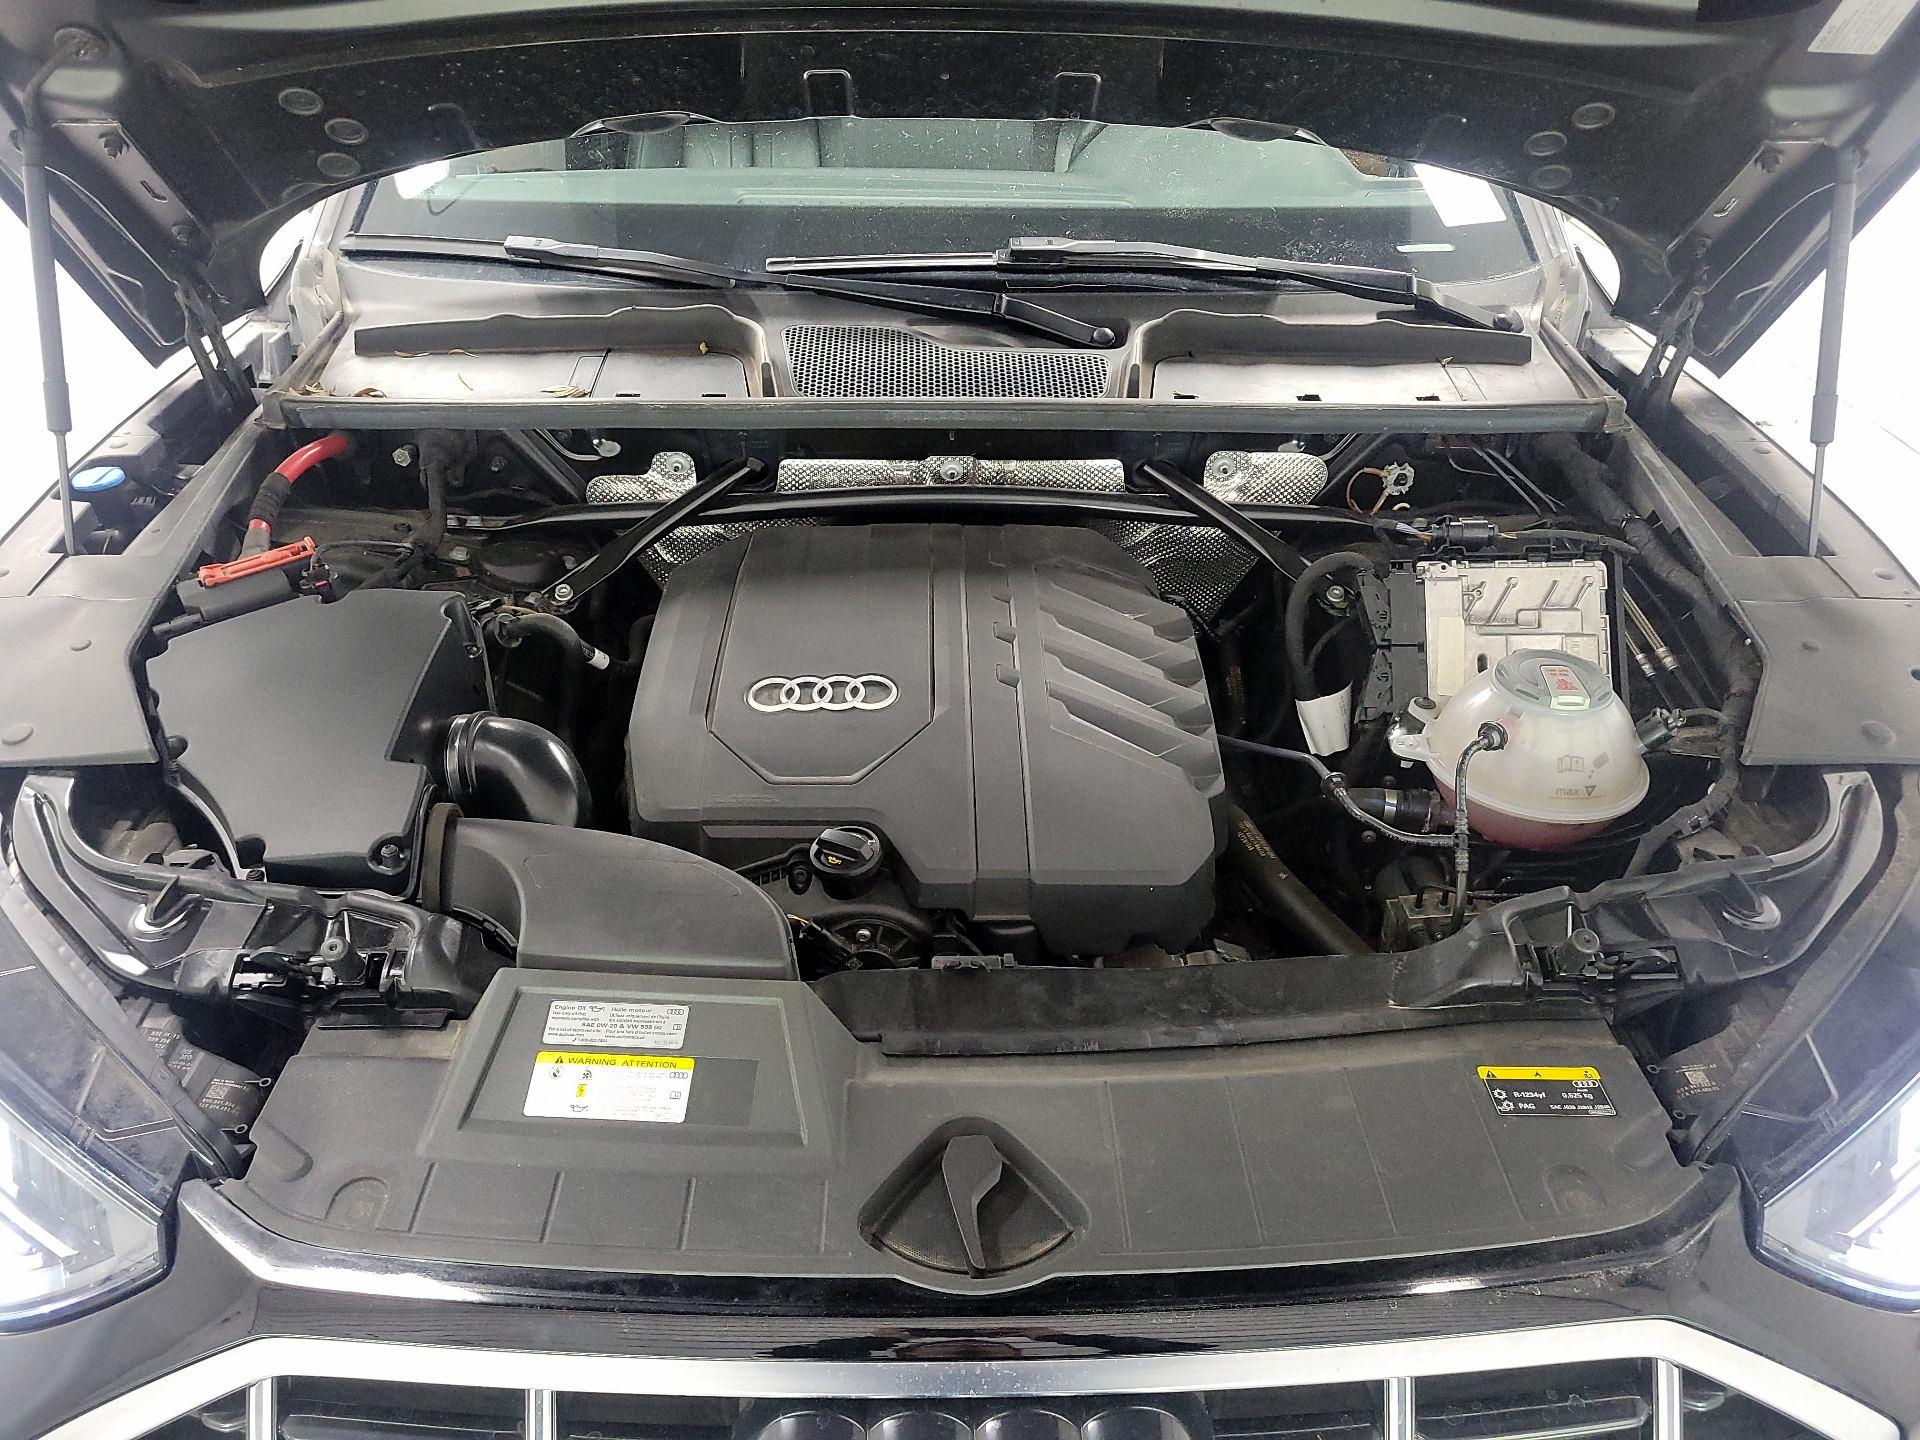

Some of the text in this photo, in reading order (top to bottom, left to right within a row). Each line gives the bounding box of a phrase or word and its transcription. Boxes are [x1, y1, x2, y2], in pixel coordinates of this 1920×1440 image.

[1554, 787, 1580, 796] max
[568, 1057, 677, 1069] WARNING ATTENTION
